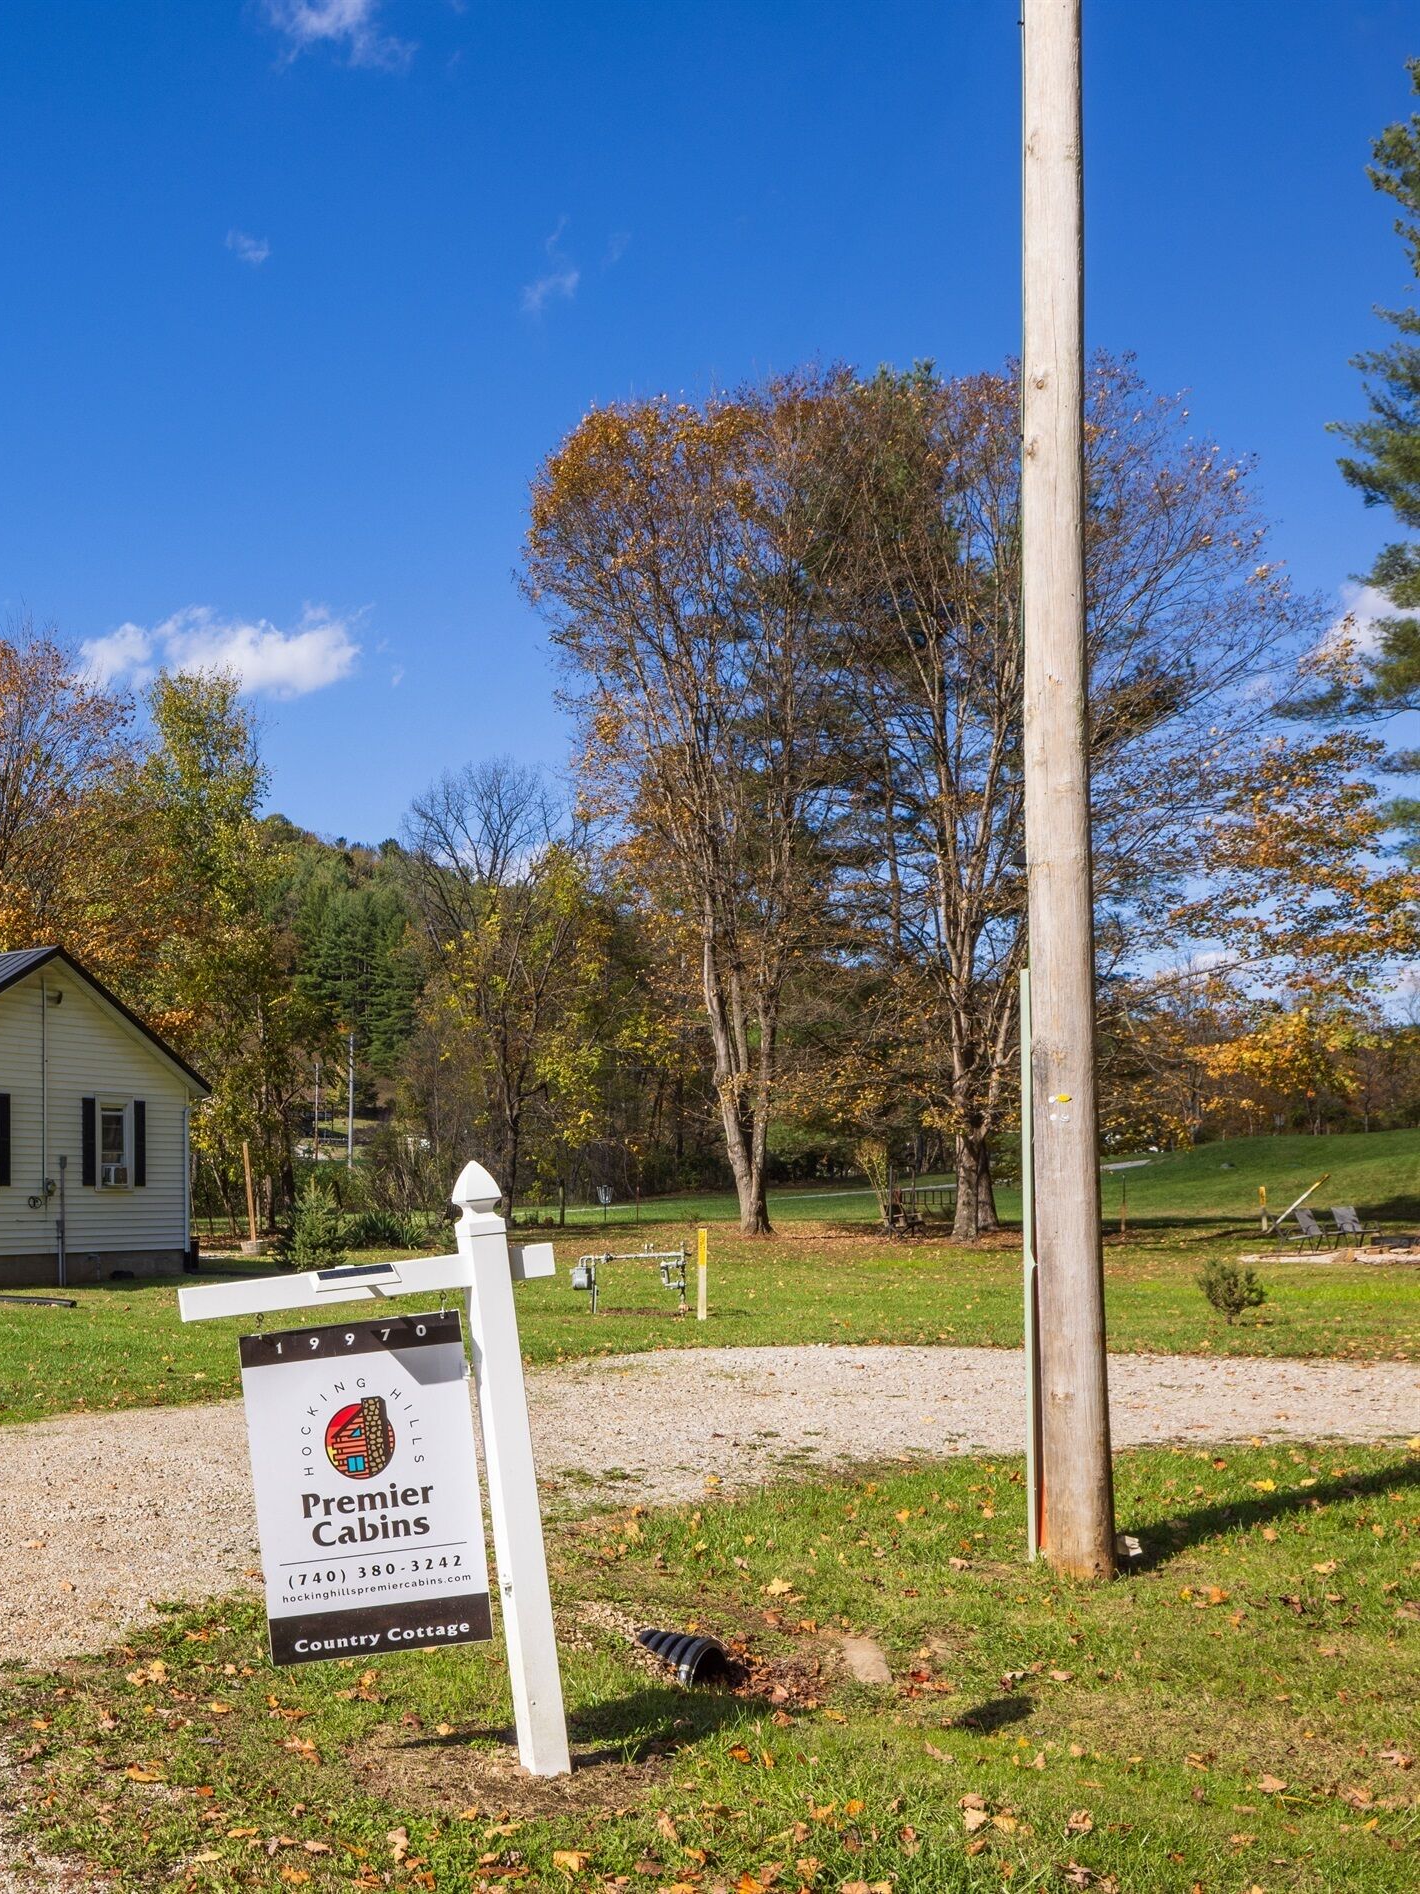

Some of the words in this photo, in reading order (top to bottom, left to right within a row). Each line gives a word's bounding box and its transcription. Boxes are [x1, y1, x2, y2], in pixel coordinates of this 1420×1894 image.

[275, 1324, 427, 1355] 19970
[300, 1377, 366, 1476] HOCKING
[390, 1388, 425, 1463] HILLS
[300, 1482, 434, 1519] Premier
[311, 1514, 431, 1548] Cabins
[282, 1573, 472, 1604] hockinghillspremiercabins.com
[288, 1568, 347, 1590] (740)
[358, 1554, 463, 1580] 380-3242
[294, 1633, 381, 1653] Country
[387, 1622, 470, 1642] Cottage
